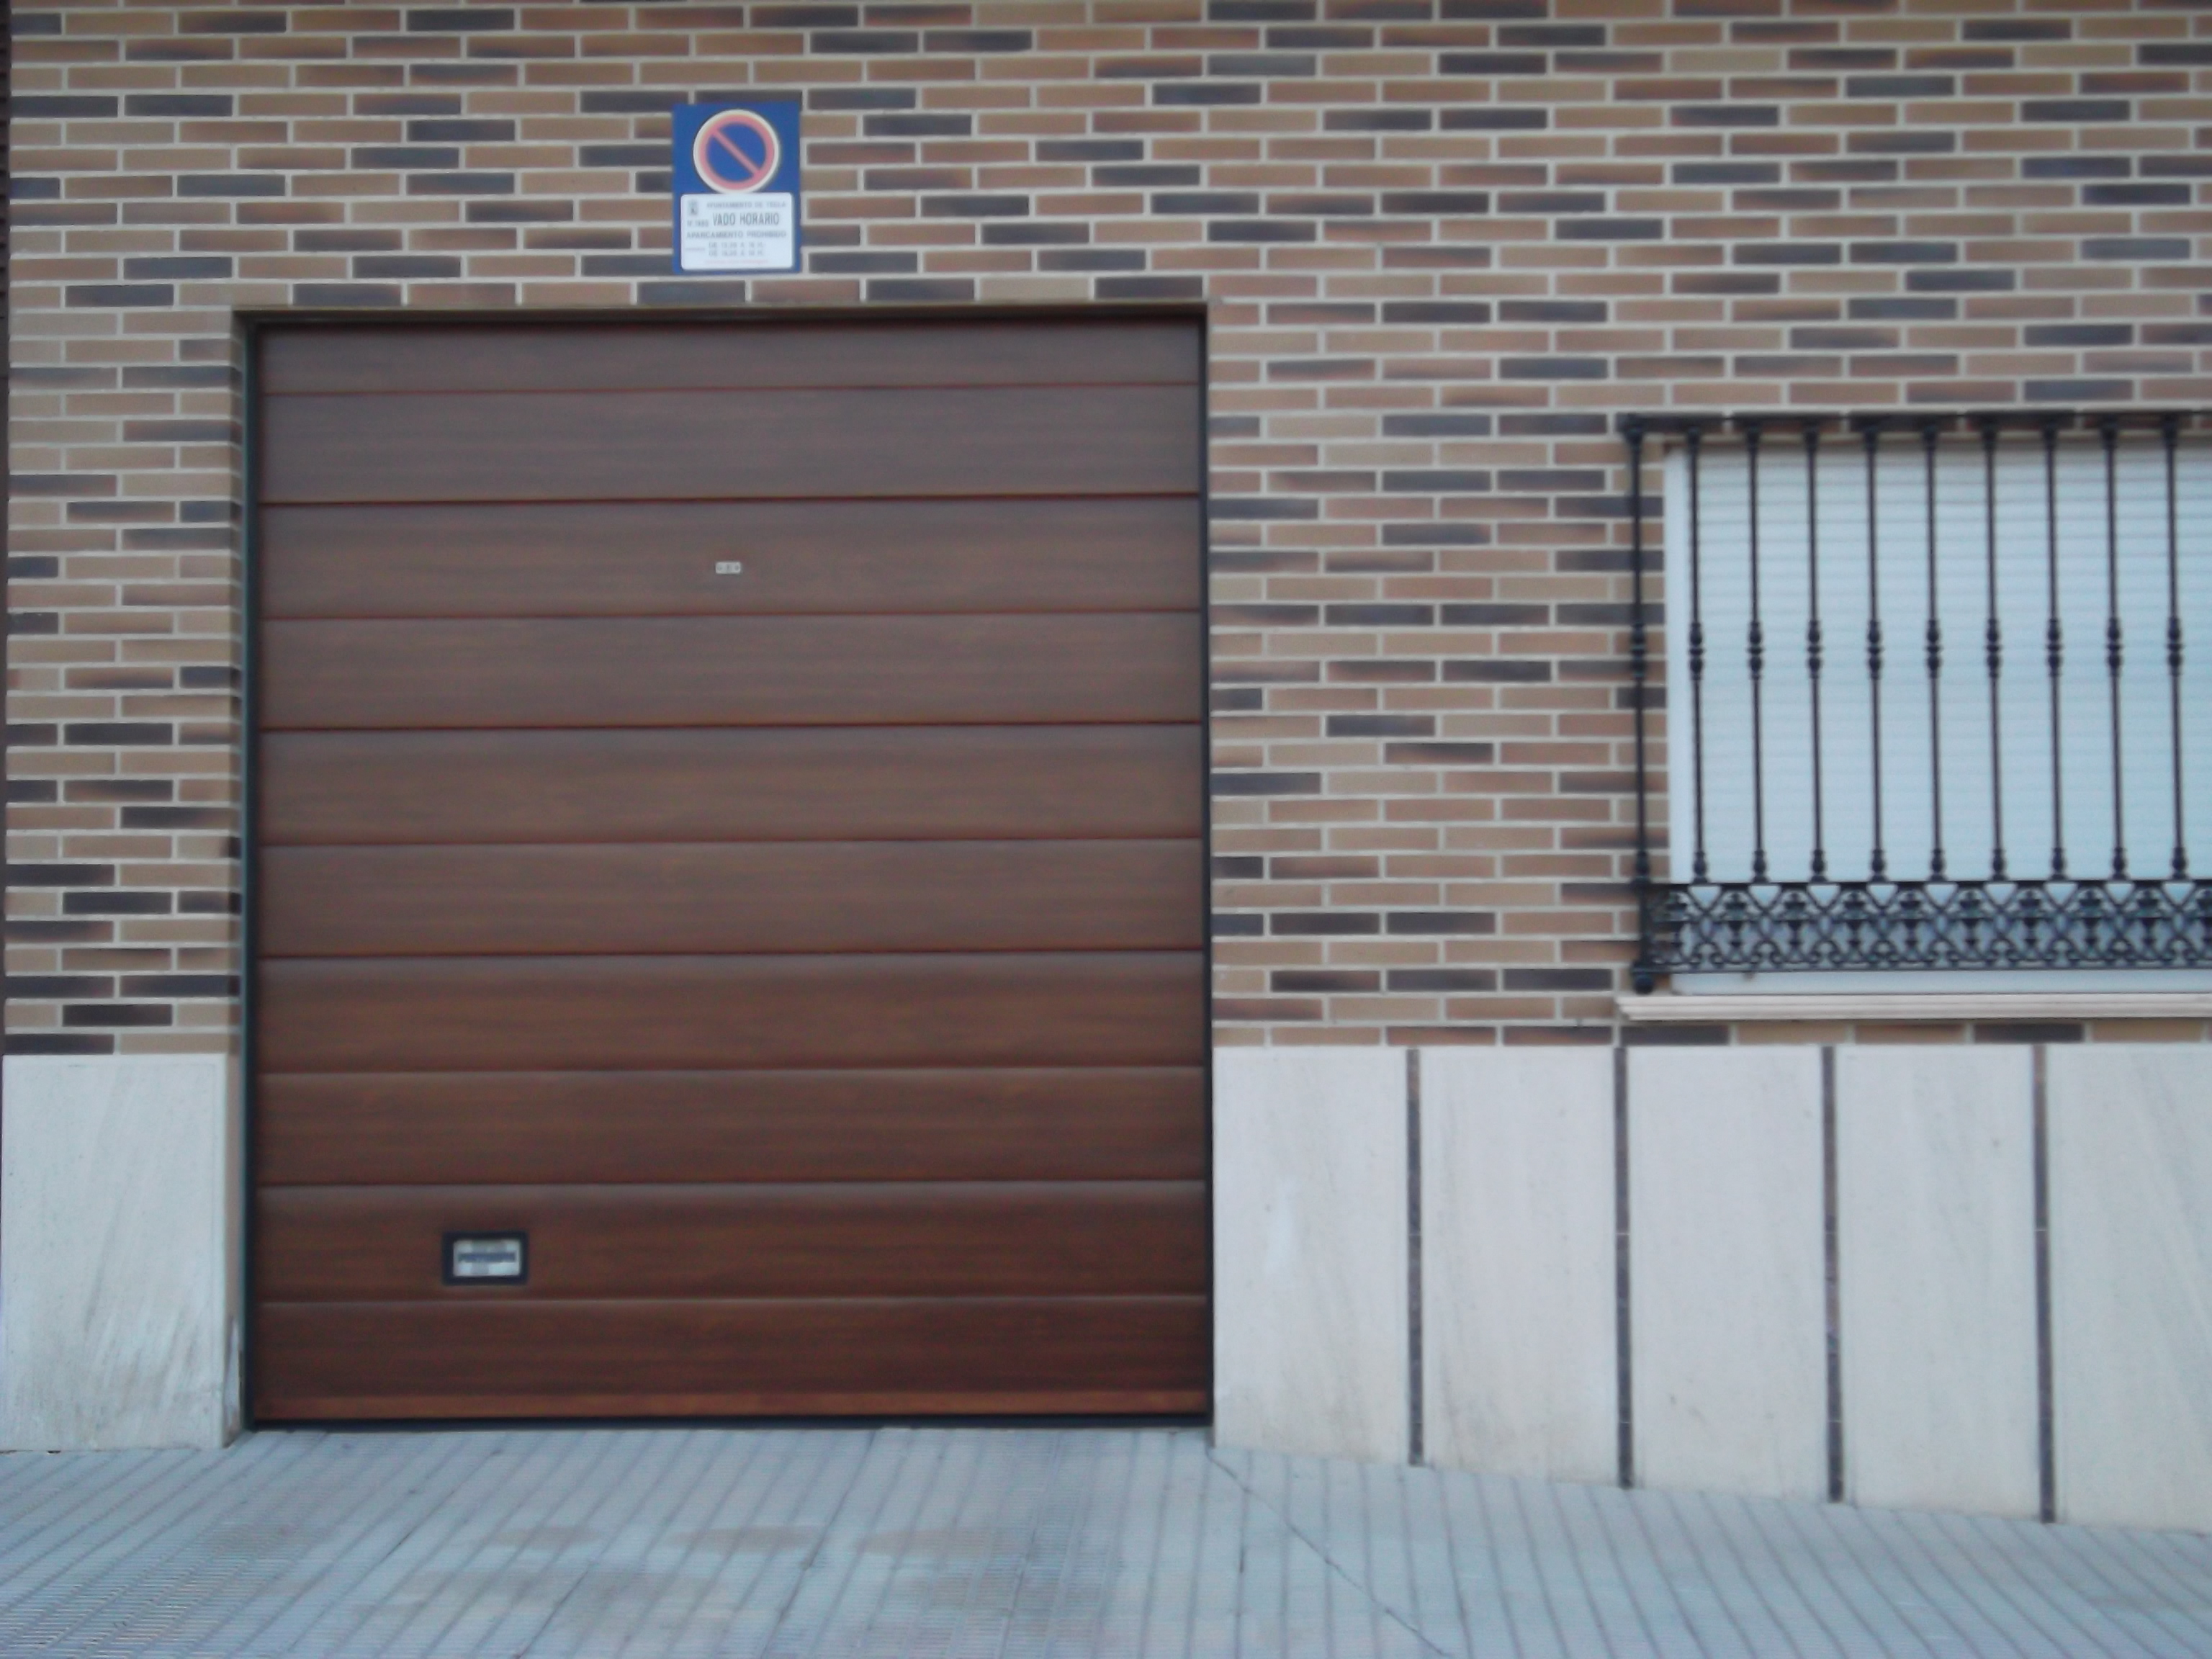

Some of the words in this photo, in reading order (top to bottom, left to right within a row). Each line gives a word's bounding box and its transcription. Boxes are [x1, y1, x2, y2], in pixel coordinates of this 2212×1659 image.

[712, 212, 736, 227] VADO
[739, 212, 780, 226] HORARIO
[686, 230, 744, 239] APARCAMIENTO
[746, 230, 787, 238] PROHIBIDO
